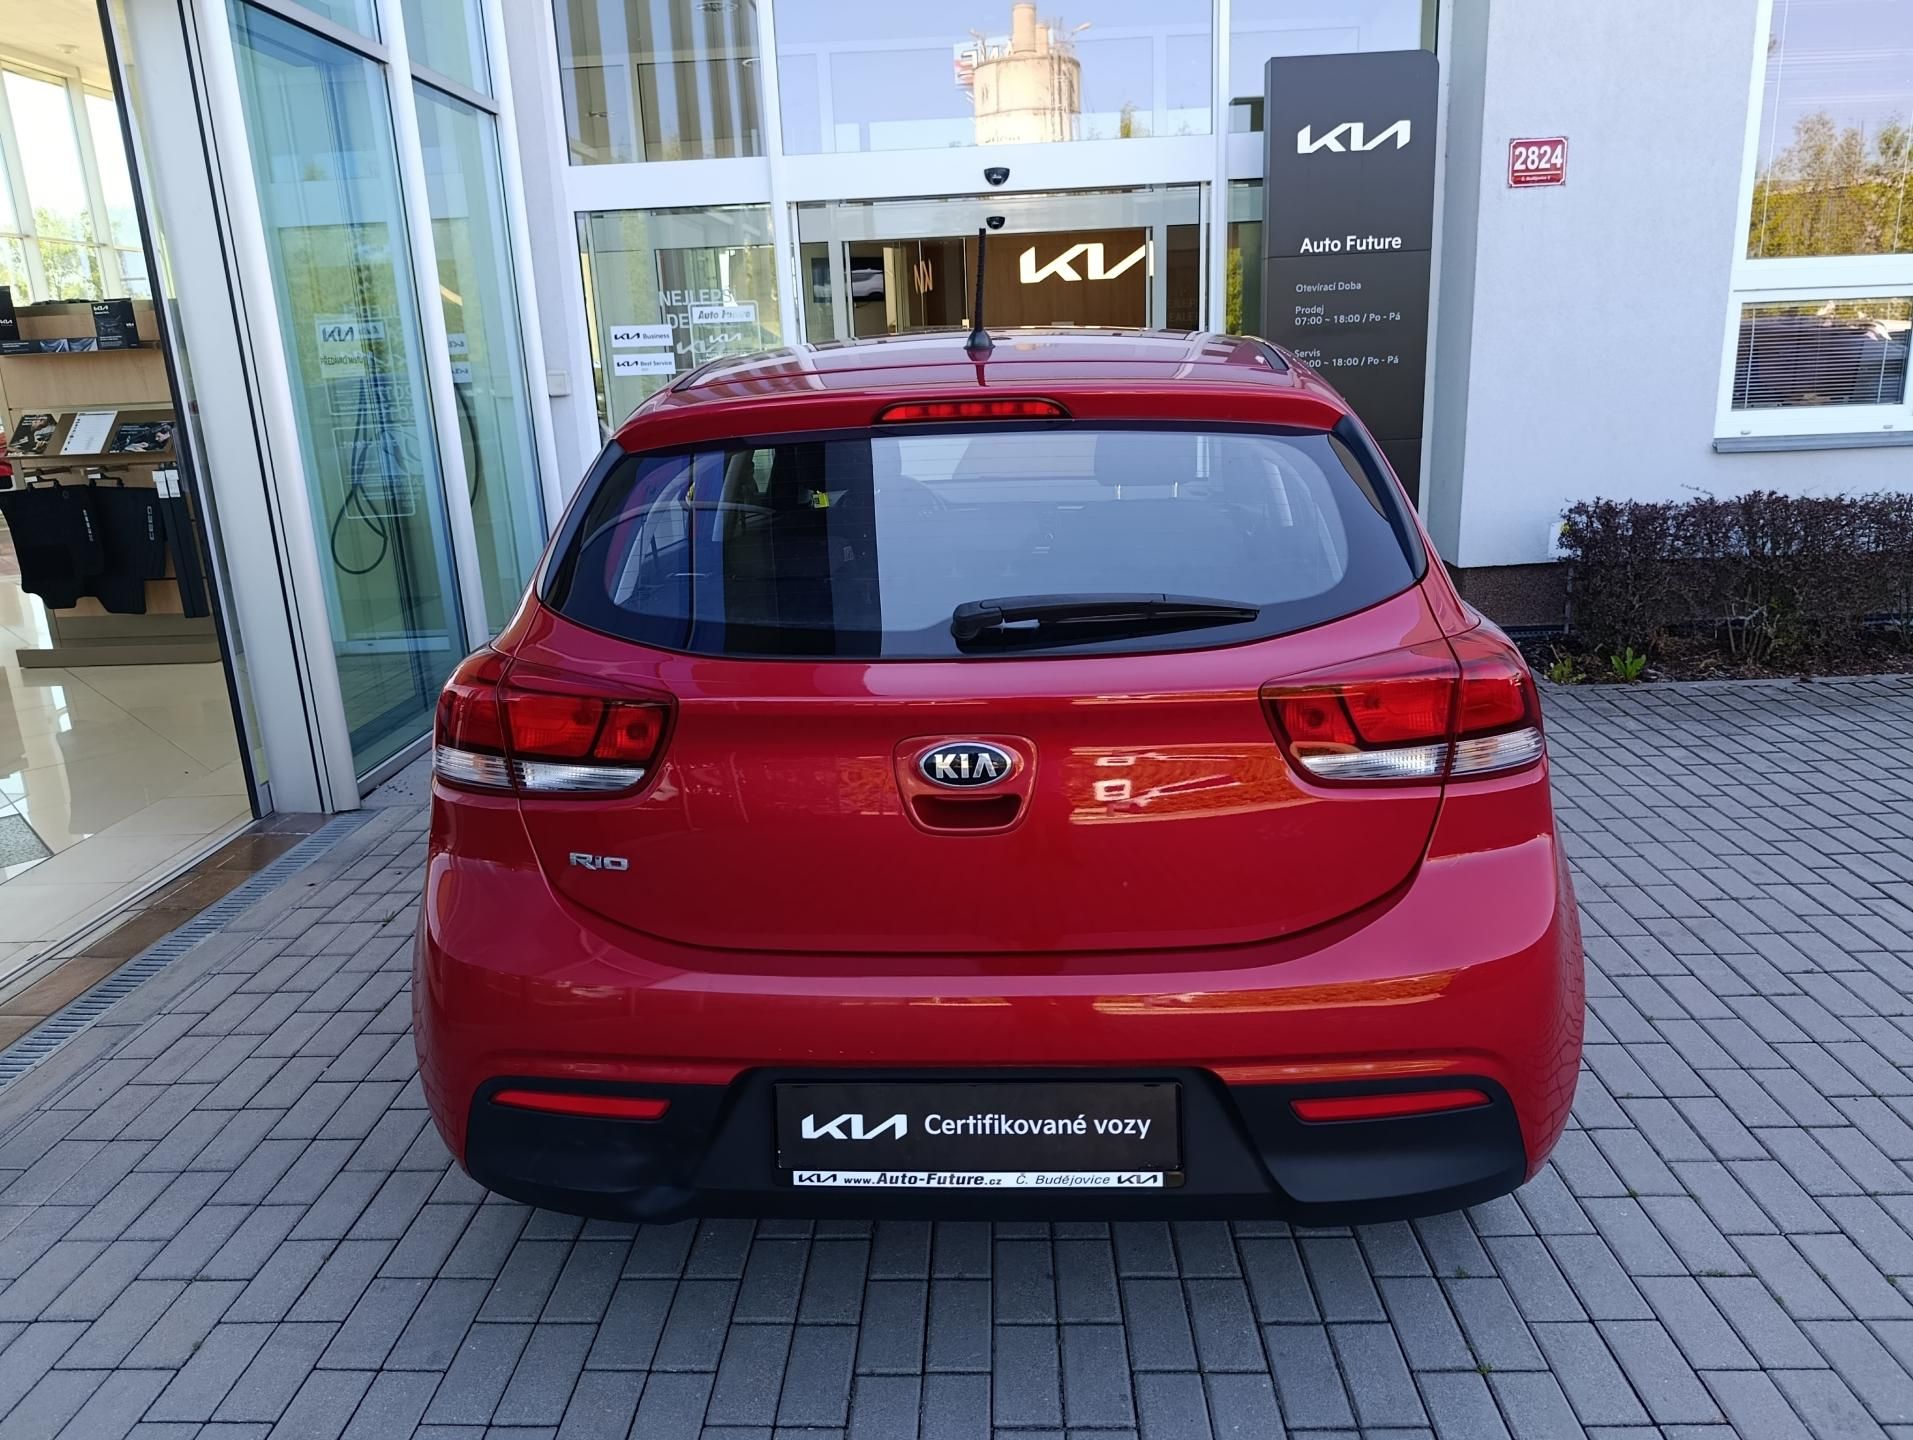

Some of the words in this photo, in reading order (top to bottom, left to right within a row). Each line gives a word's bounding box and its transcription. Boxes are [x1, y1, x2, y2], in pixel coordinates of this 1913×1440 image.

[1297, 120, 1411, 154] KIA
[1513, 144, 1563, 170] 2824
[1300, 237, 1341, 253] Auto
[1346, 235, 1402, 251] Future
[1020, 243, 1153, 284] KIA
[1338, 281, 1362, 291] Doba
[1295, 304, 1325, 315] Prodej
[1294, 316, 1323, 326] 07:00
[1333, 314, 1360, 324] 18:00
[1369, 313, 1381, 322] Po
[1389, 312, 1401, 321] Pá
[322, 326, 355, 342] KIA
[614, 332, 640, 340] KIA
[1294, 349, 1321, 358] Servis
[1332, 357, 1359, 367] 18:00
[1367, 356, 1379, 365] Po
[1387, 355, 1399, 364] Pá
[934, 753, 998, 779] KIA
[801, 1113, 908, 1140] KIA
[924, 1112, 1087, 1135] Certifikované
[1094, 1117, 1151, 1139] vozy
[798, 1173, 837, 1183] KIA
[844, 1173, 1002, 1186] www.Auto-Future.cz
[1015, 1173, 1029, 1185] Č.
[1035, 1174, 1110, 1187] Budějovice
[1117, 1174, 1158, 1184] KIA
